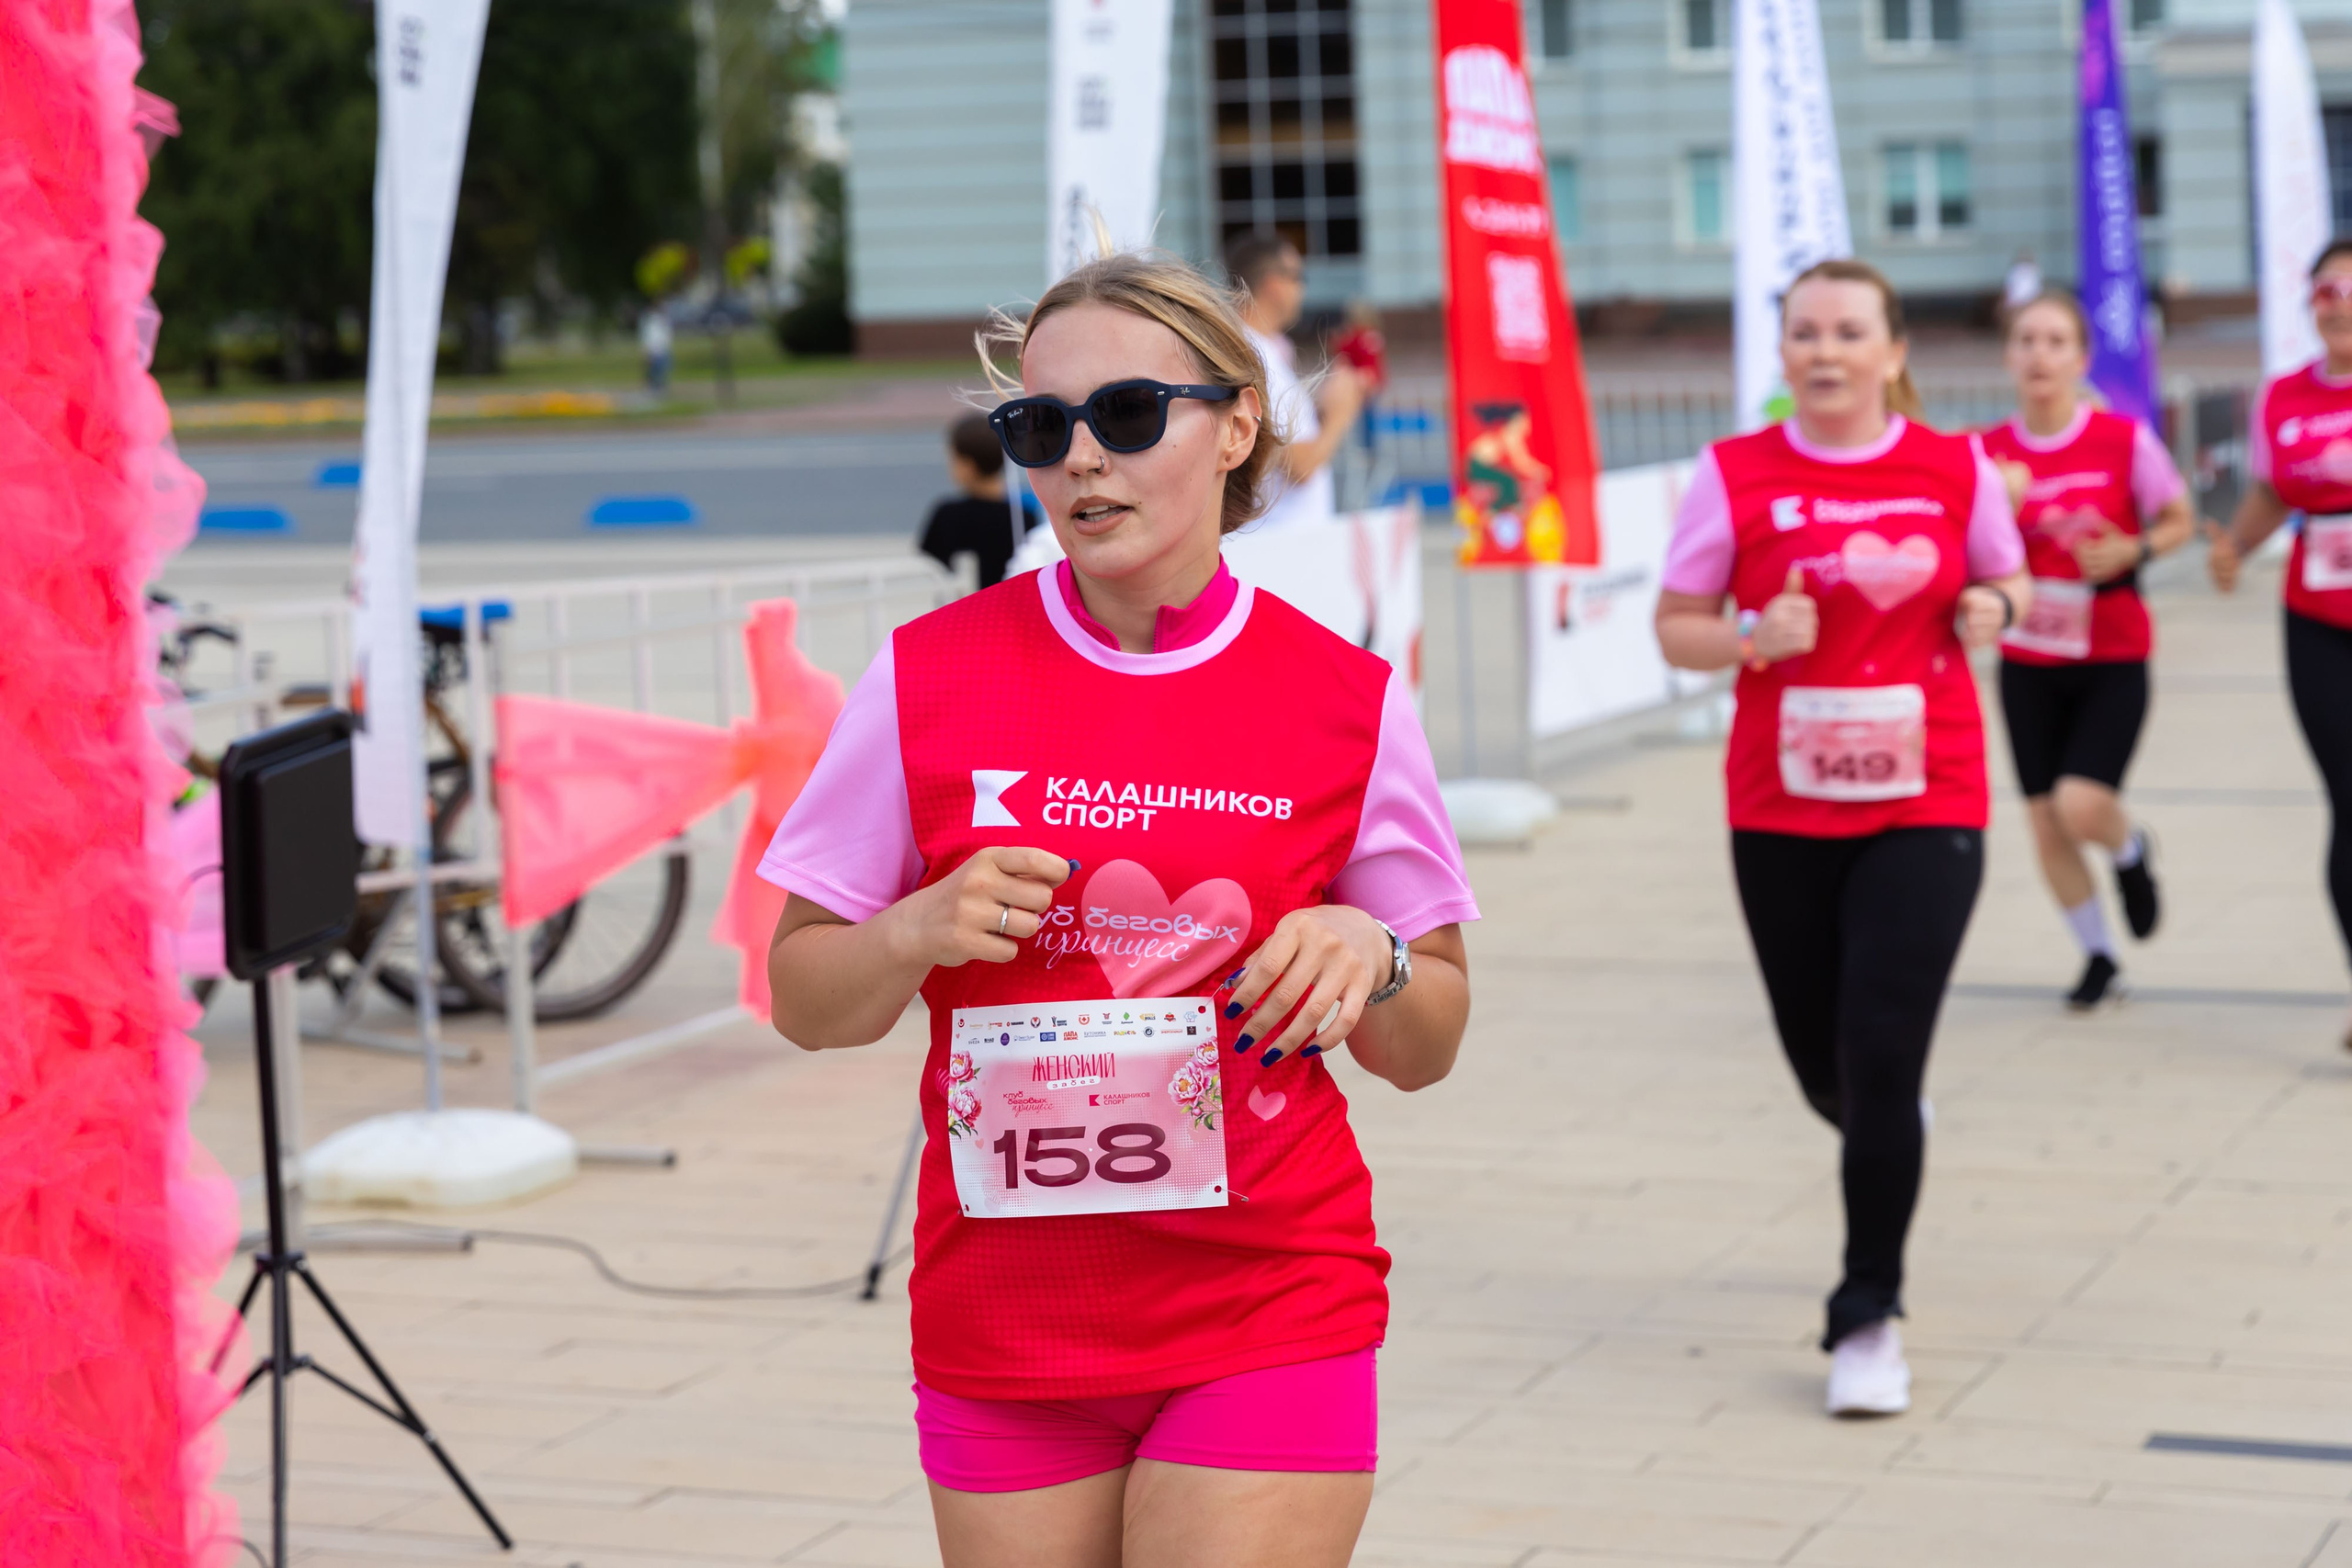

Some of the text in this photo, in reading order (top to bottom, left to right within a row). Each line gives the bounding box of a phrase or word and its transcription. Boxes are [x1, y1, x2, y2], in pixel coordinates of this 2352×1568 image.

[1812, 750, 1898, 782] 149
[1046, 776, 1294, 820] КАЛАШНИКОВ
[1042, 802, 1157, 830] СПОРТ
[1036, 905, 1240, 943] уб беговых
[1035, 930, 1191, 969] принцесс
[1032, 1052, 1115, 1082] ЖЕНСКИЙ
[1002, 1090, 1023, 1099] клуб
[1052, 1078, 1096, 1089] забег
[1007, 1097, 1047, 1105] беговых
[992, 1122, 1171, 1190] 158
